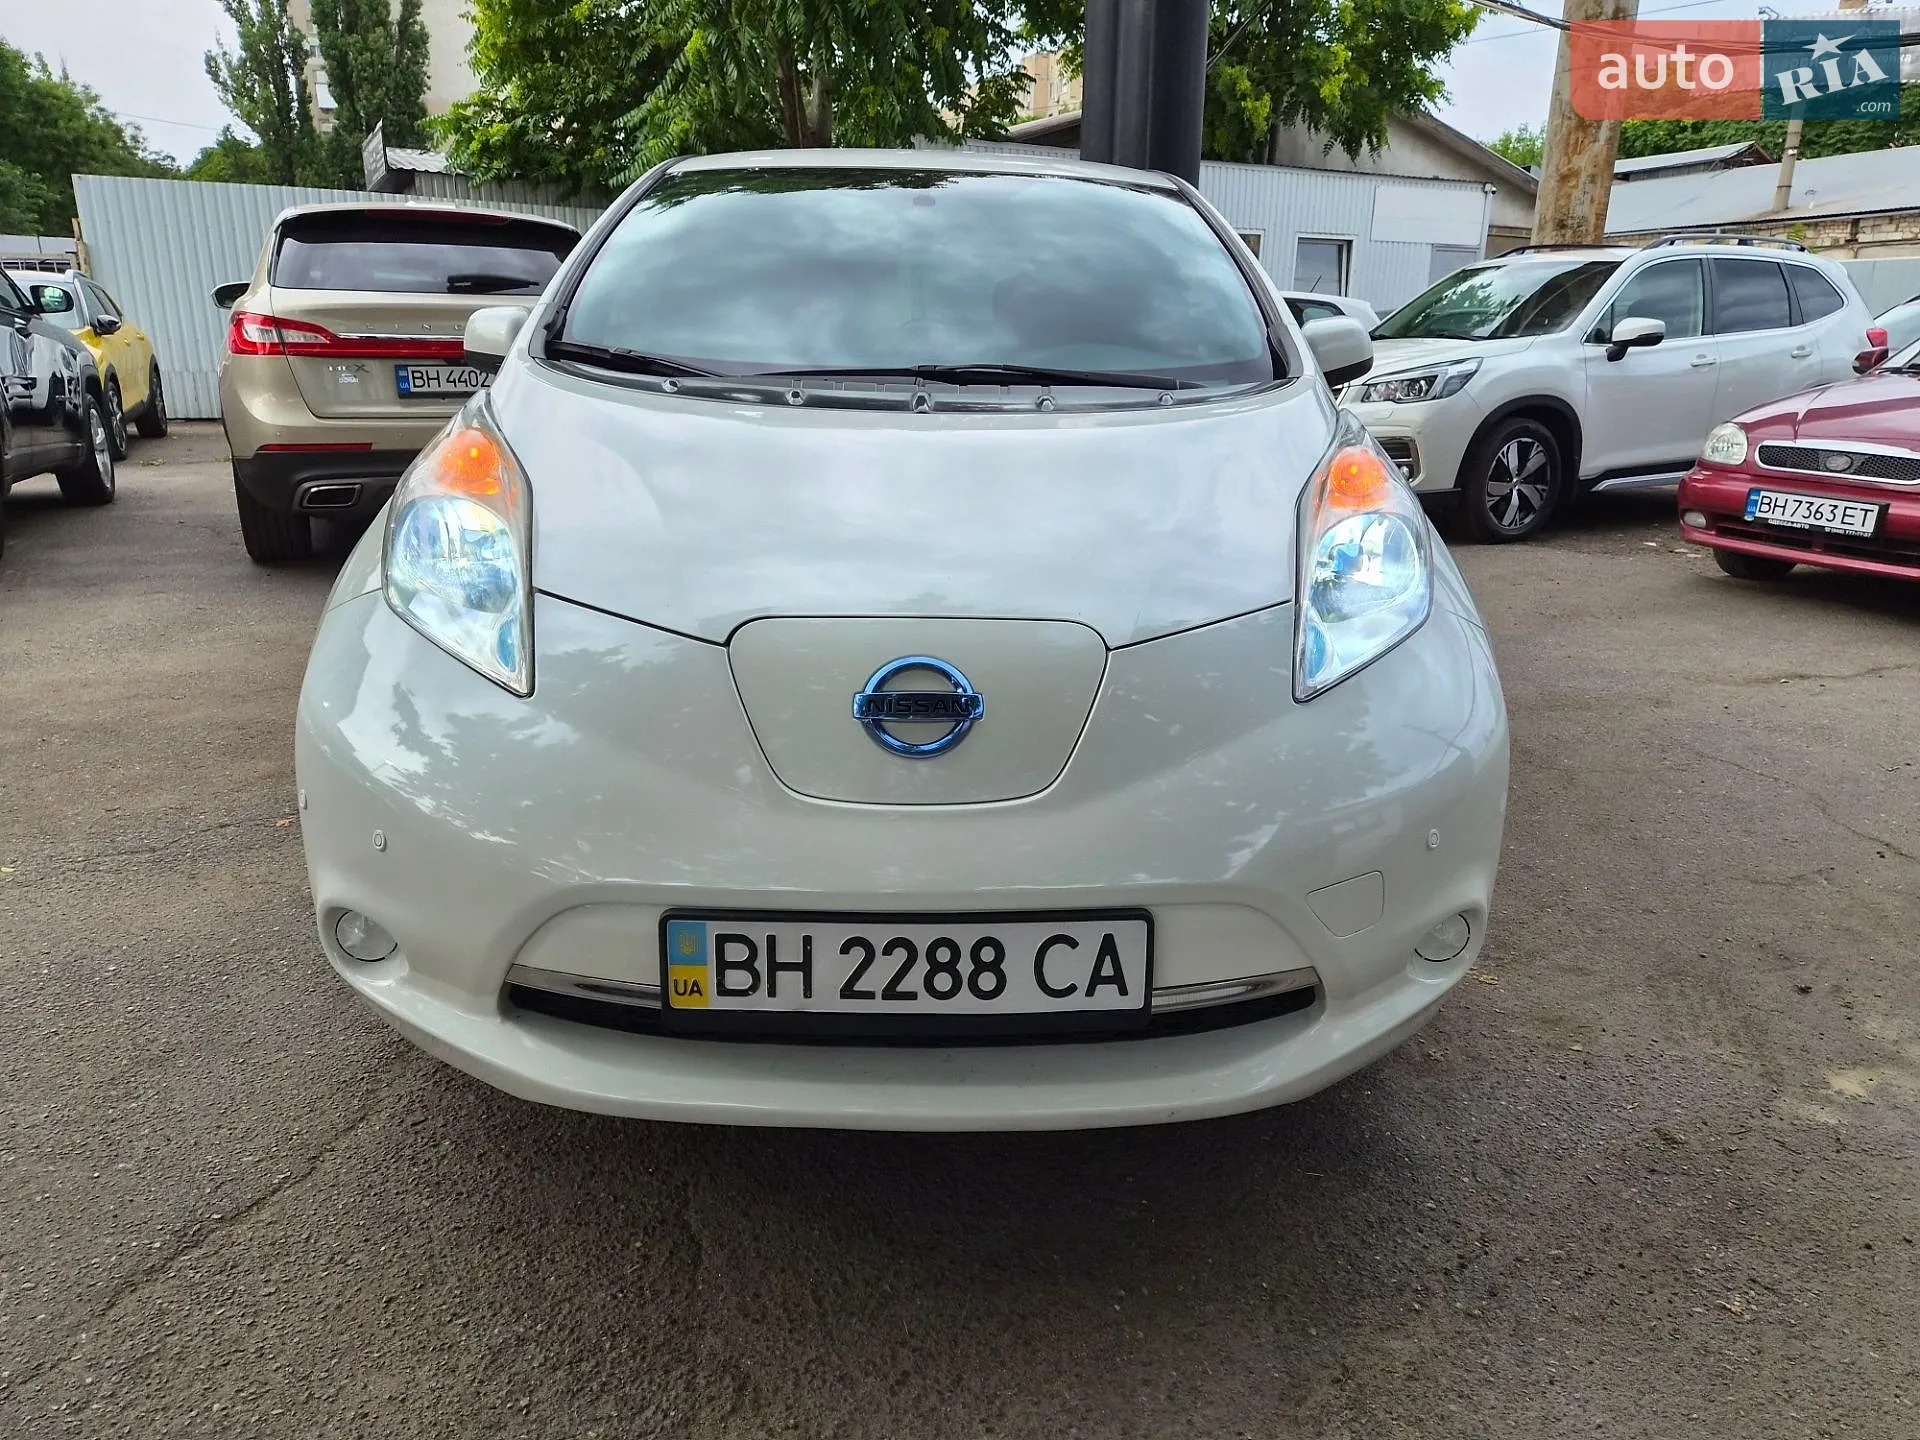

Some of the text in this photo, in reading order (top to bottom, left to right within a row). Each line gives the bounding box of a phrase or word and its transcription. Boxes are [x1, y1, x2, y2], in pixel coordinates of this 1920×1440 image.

[411, 370, 441, 388] BH
[446, 370, 491, 388] 4402
[1758, 495, 1788, 516] BH
[1791, 499, 1838, 523] 7363
[1840, 507, 1874, 527] ET
[866, 697, 970, 714] NISSAN
[673, 932, 1130, 1001] UA BH 2288 CA
